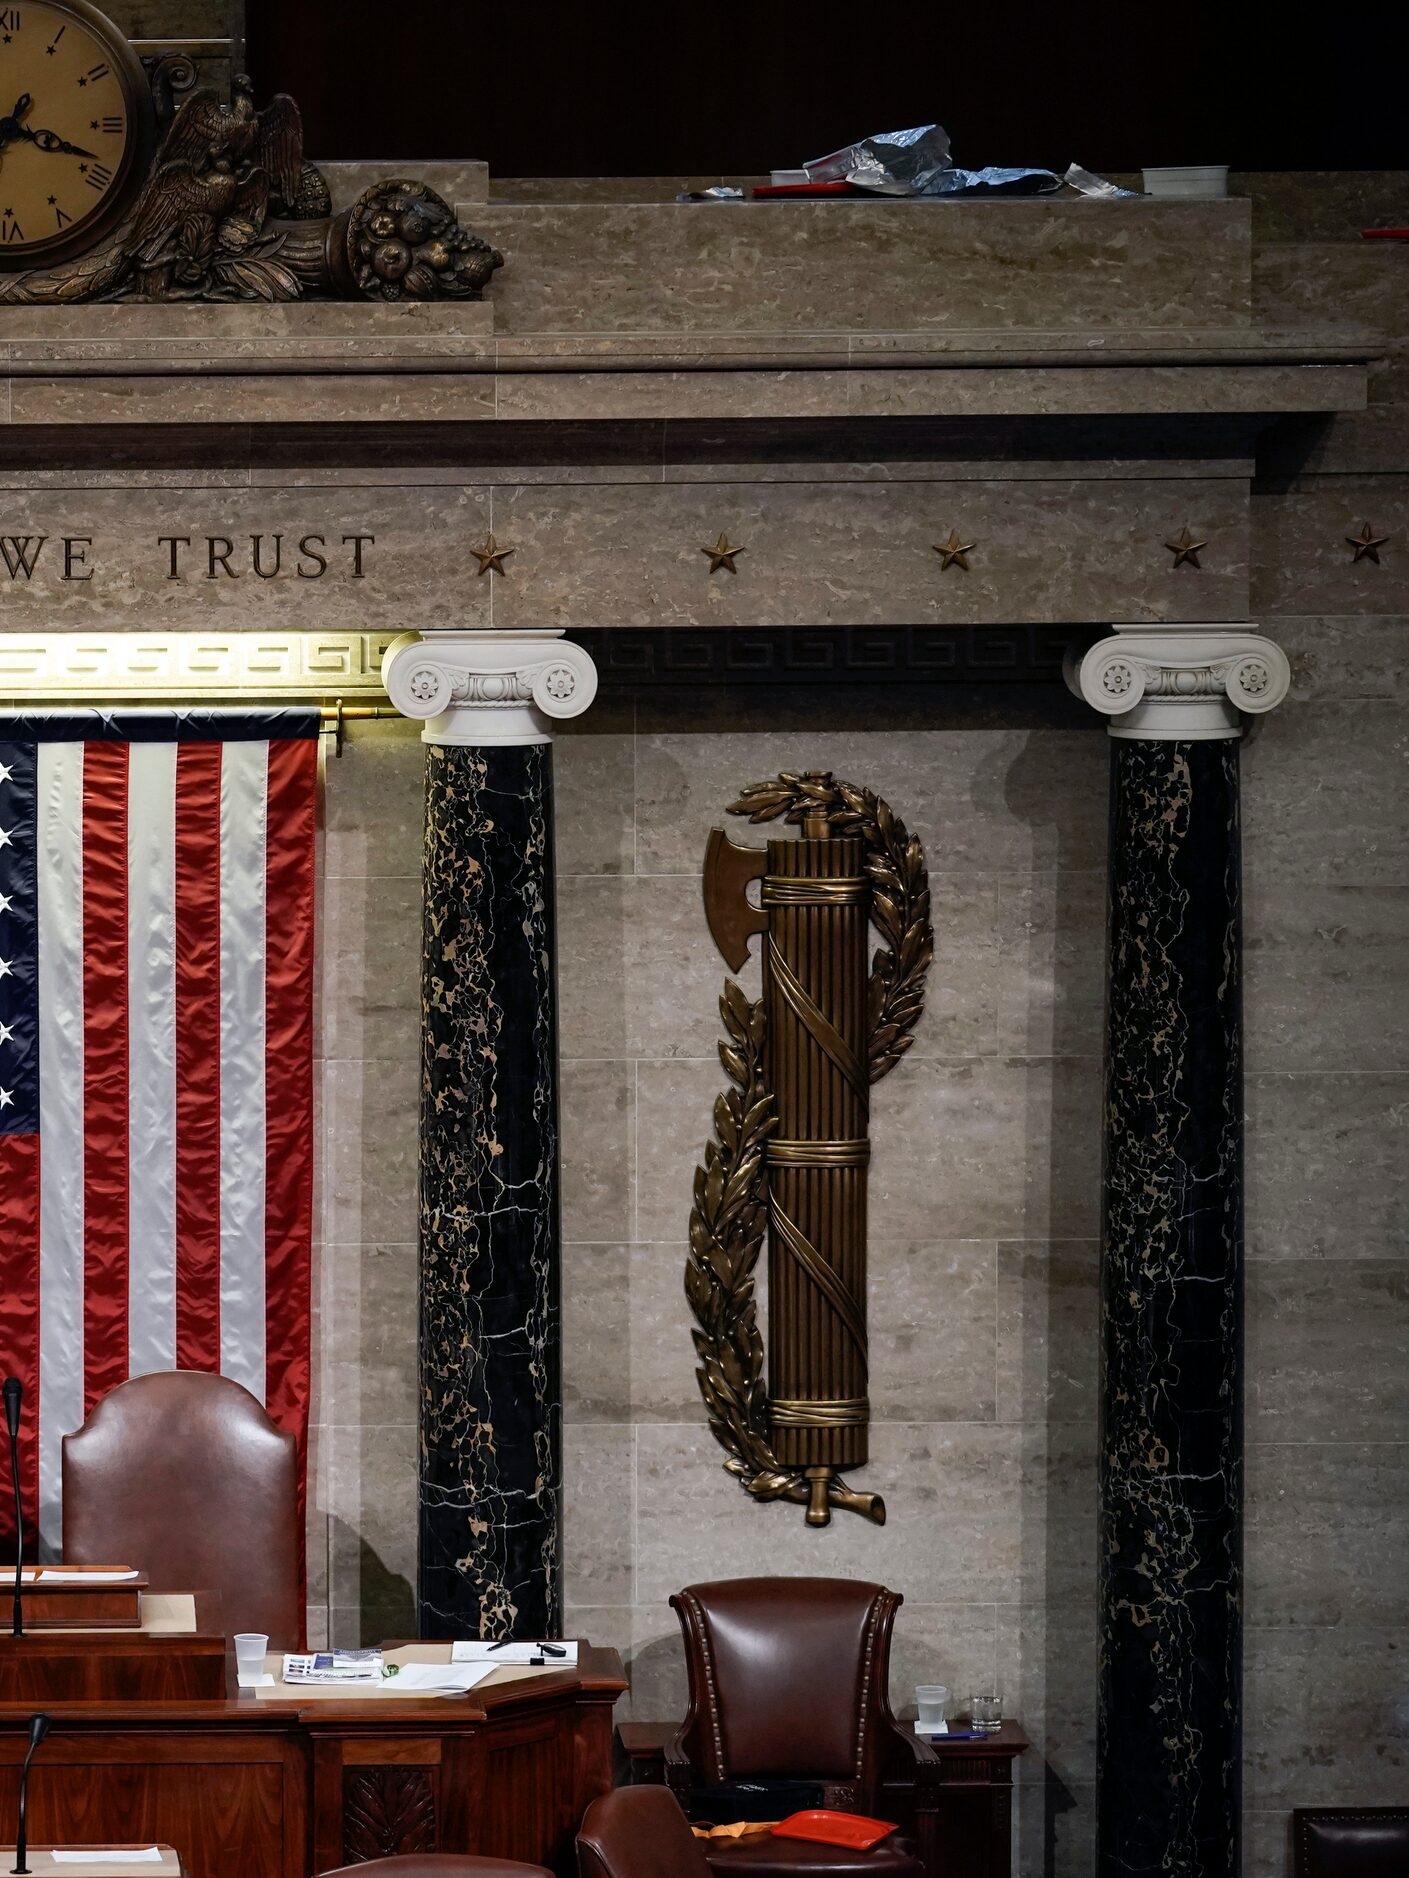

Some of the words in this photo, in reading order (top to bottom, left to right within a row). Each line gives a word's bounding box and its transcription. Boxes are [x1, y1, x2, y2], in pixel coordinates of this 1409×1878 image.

[102, 116, 123, 133] III
[2, 220, 25, 241] VI
[157, 534, 376, 581] TRUST
